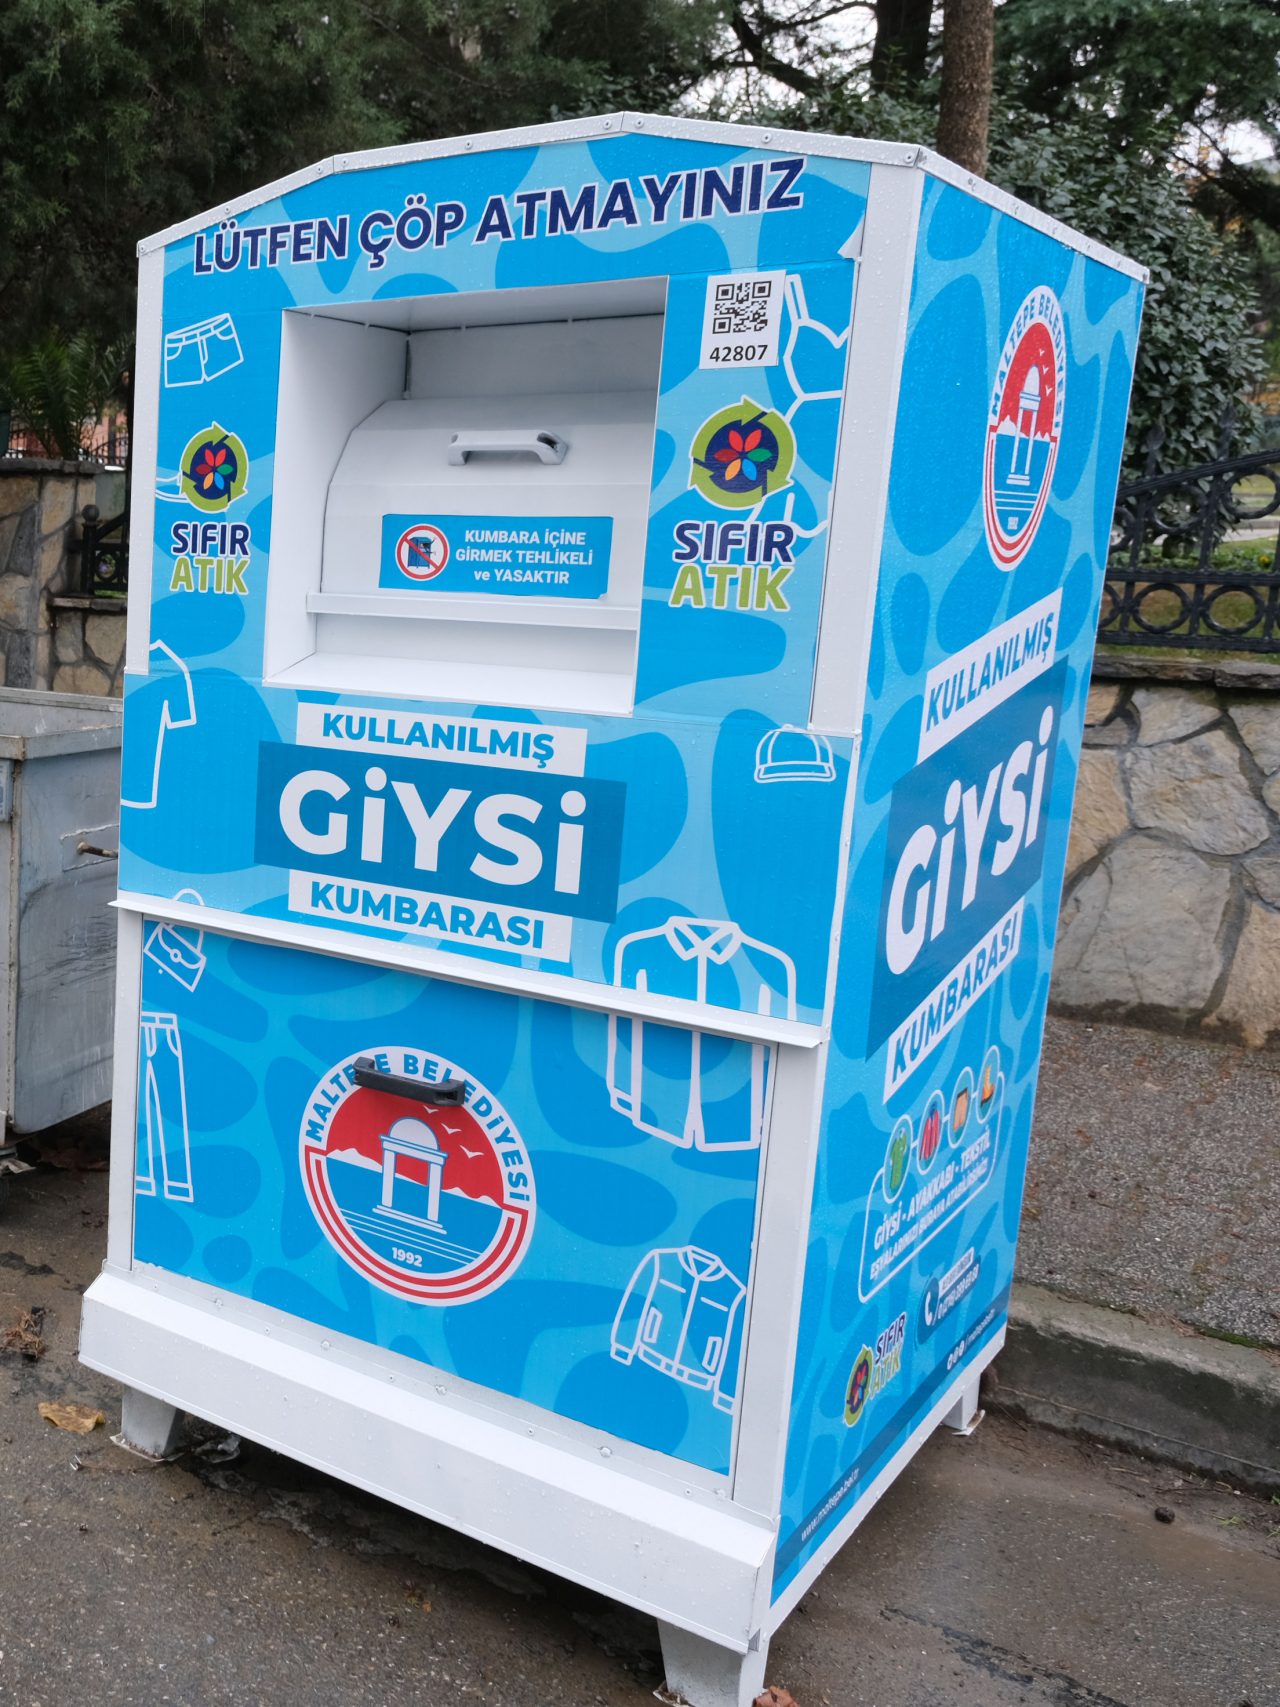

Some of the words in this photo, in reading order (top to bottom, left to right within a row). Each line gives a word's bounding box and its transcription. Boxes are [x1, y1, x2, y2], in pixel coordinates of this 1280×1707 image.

[194, 214, 349, 276] LÜTFEN
[360, 194, 463, 270] ÇÖP
[473, 157, 807, 243] ATMAYINIZ
[709, 344, 769, 363] 42807
[991, 297, 1036, 417] MALTEPE
[172, 524, 250, 557] SIFIR
[455, 548, 512, 564] GİRMEK
[516, 549, 593, 566] TEHLİKELİ
[464, 529, 540, 545] KUMBARA
[544, 529, 587, 548] İÇİNE
[673, 522, 795, 564] SIFIR
[171, 558, 249, 595] ATIK
[474, 571, 490, 582] ve
[494, 569, 570, 584] YASAKTIR
[670, 564, 791, 611] ATIK
[925, 612, 1054, 733] KULLANILMIŞ
[322, 712, 555, 768] KULLANILMIŞ
[310, 881, 544, 949] KUMBARASI
[892, 917, 1018, 1085] KUMBARASI
[306, 1053, 391, 1142] MALTEE
[391, 1247, 423, 1268] 1992
[875, 1312, 906, 1364] SIFIR
[871, 1346, 901, 1400] ATIK
